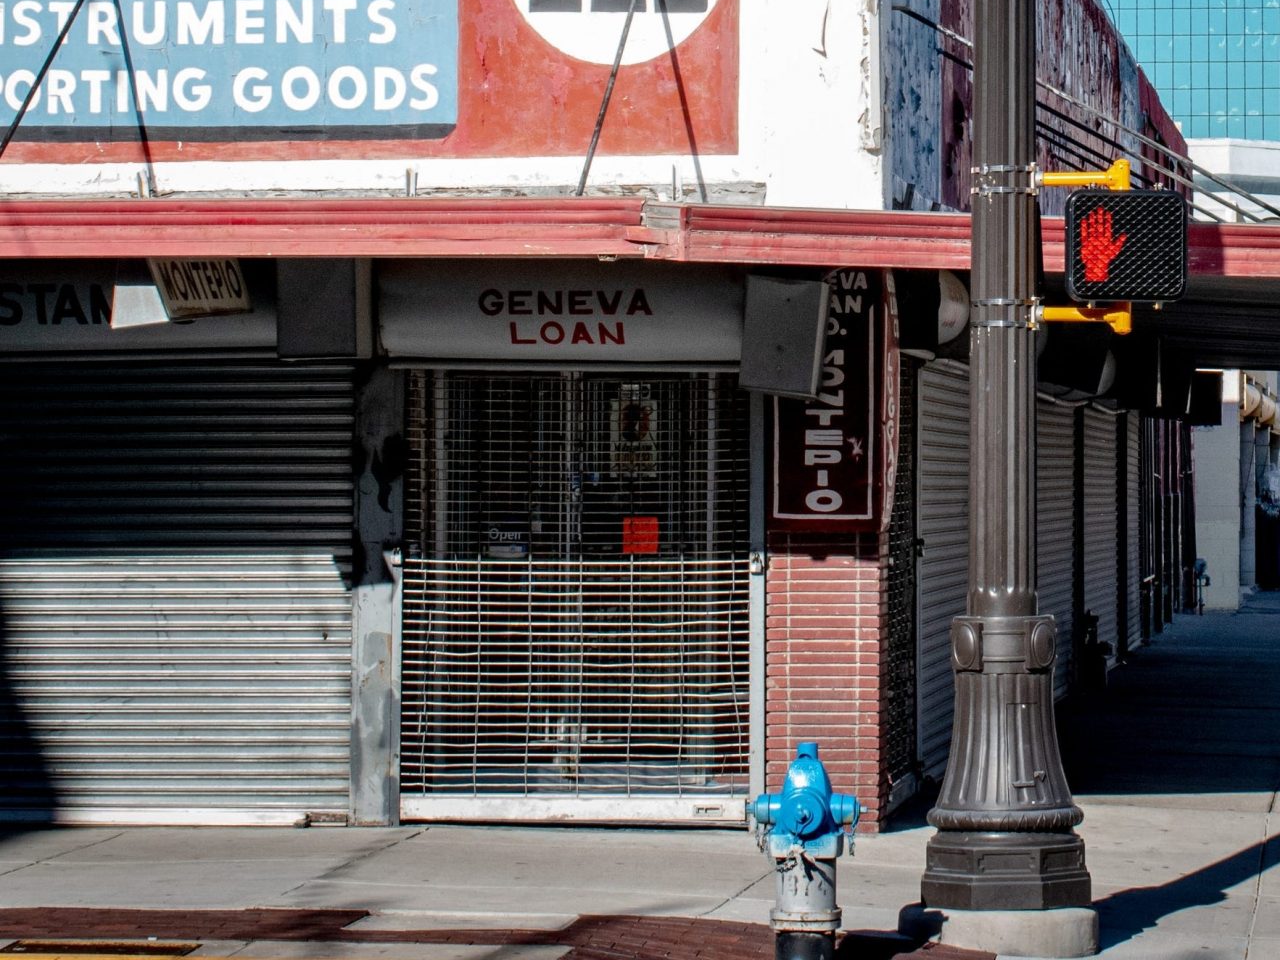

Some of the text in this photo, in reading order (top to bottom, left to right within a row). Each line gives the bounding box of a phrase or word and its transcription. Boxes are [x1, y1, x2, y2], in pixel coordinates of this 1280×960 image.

[0, 63, 439, 115] ORTING GOODS
[157, 260, 242, 301] MONTEPIO
[477, 288, 653, 316] GENEVA
[509, 321, 626, 345] LOAN
[488, 527, 522, 542] Open
